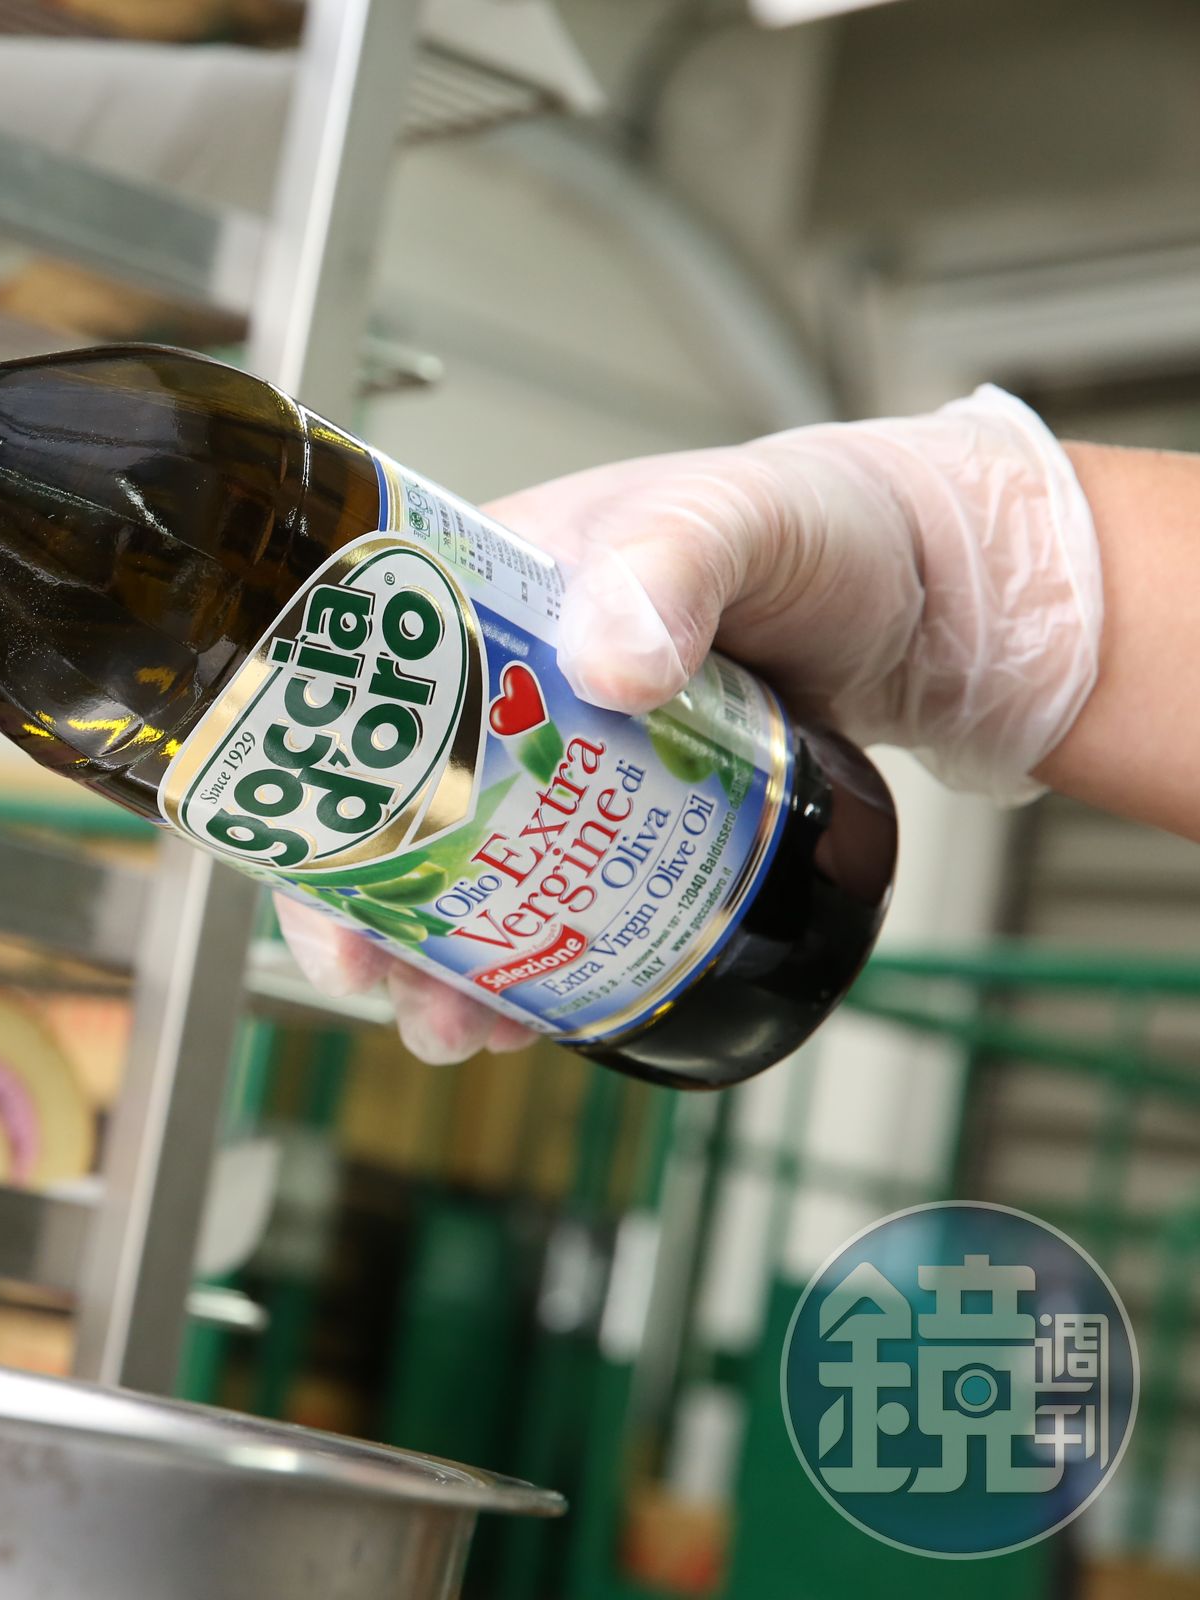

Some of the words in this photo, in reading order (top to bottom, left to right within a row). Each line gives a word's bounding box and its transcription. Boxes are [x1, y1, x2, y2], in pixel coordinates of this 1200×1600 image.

[200, 768, 233, 805] Since
[223, 731, 257, 771] 1929
[205, 584, 375, 867] goccia
[435, 874, 502, 918] Olio
[471, 738, 606, 888] Extra
[449, 788, 634, 950] Vergine
[616, 759, 647, 793] di
[601, 807, 671, 889] Oliva
[699, 810, 737, 876] Baldissero
[541, 961, 604, 997] Extra
[590, 903, 658, 957] Virgin
[646, 840, 697, 900] Olive
[682, 794, 715, 836] Oil
[631, 955, 667, 988] ITALY
[670, 866, 733, 954] www.gocciadoro.it
[481, 938, 583, 989] Selezione
